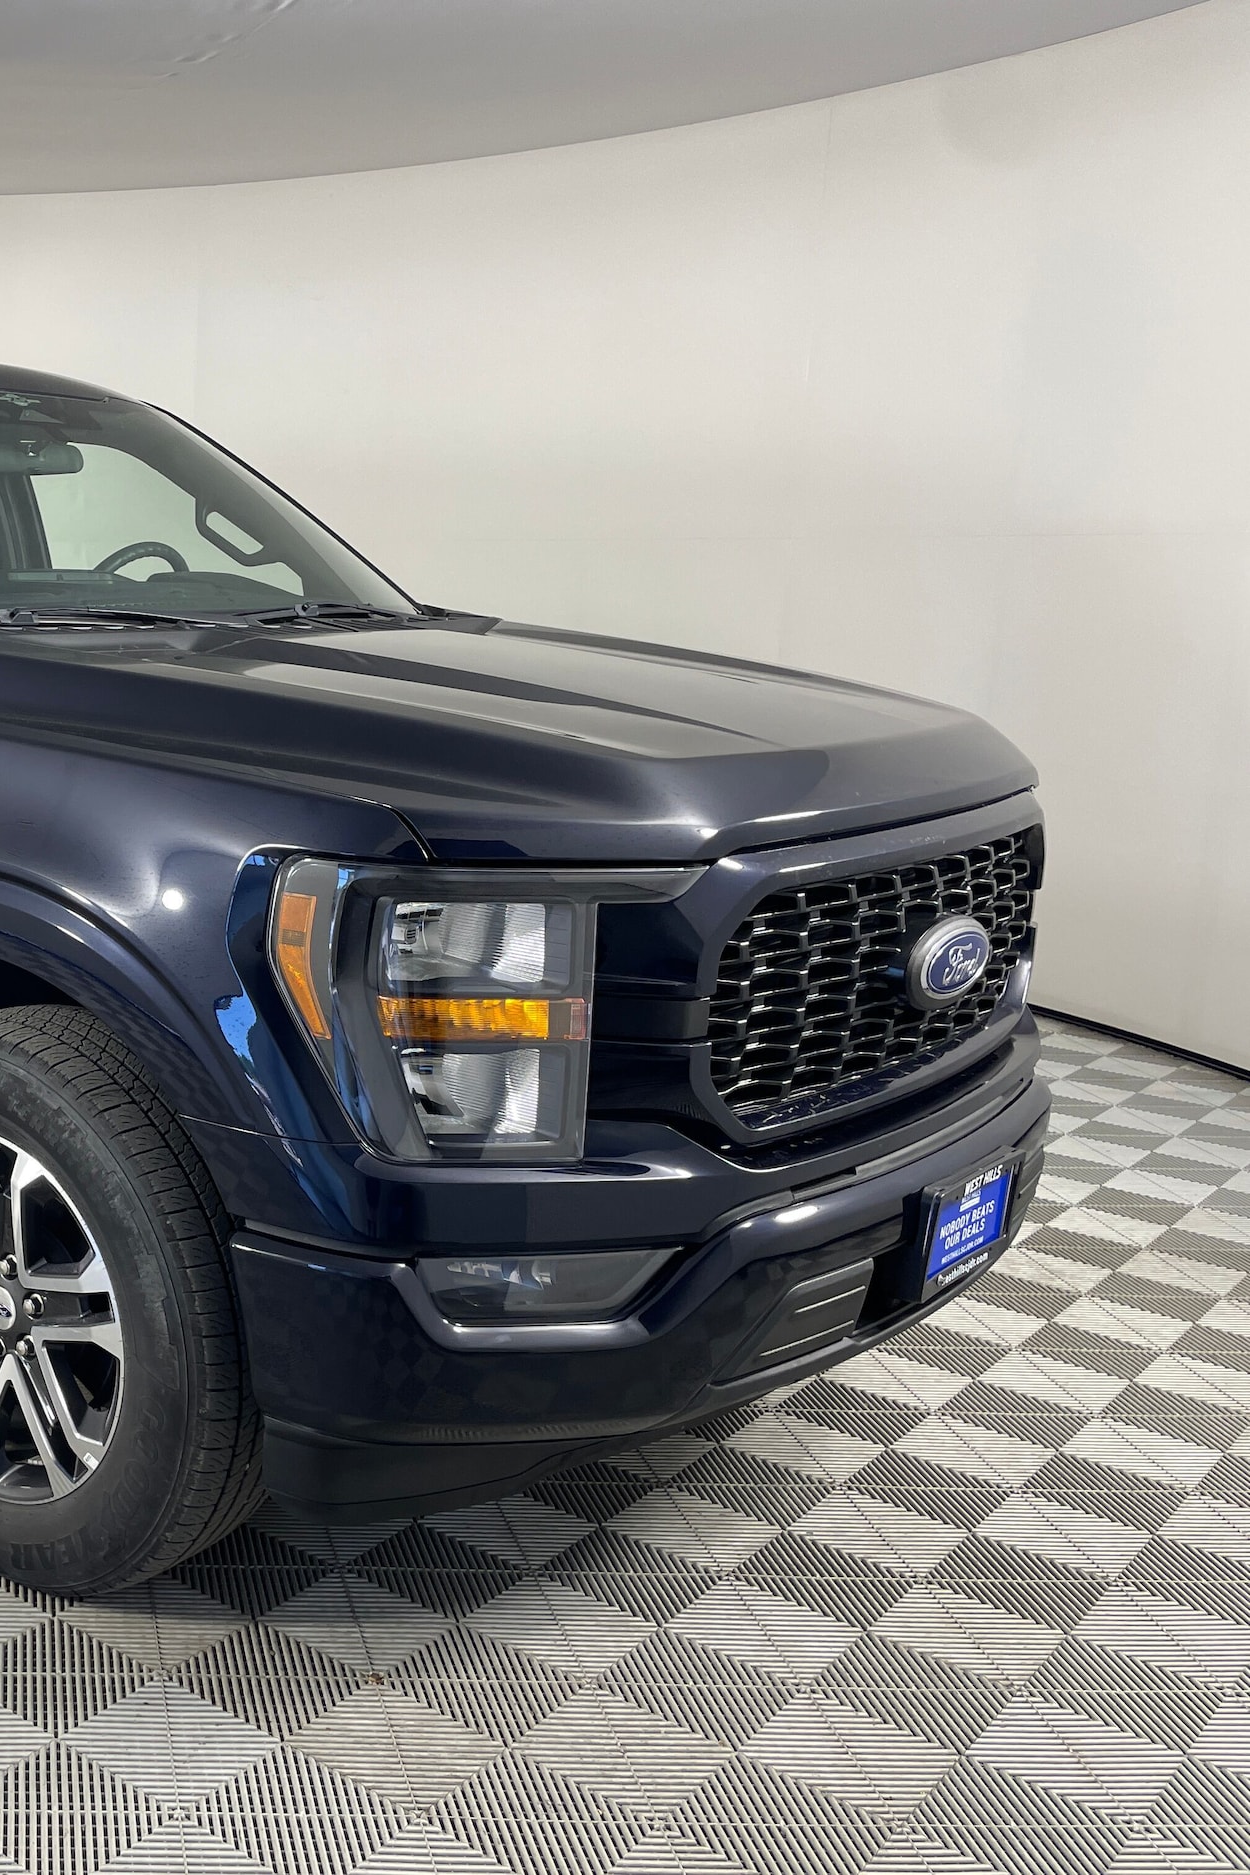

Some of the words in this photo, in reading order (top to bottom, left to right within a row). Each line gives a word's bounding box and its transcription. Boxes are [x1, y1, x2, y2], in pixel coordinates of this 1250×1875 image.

[942, 943, 981, 986] Ford
[964, 1174, 984, 1196] WEST
[982, 1164, 1003, 1186] HILLS
[939, 1211, 972, 1240] NOBODY
[971, 1199, 995, 1222] BEATS
[944, 1231, 961, 1250] OUR
[961, 1219, 985, 1241] DEALS
